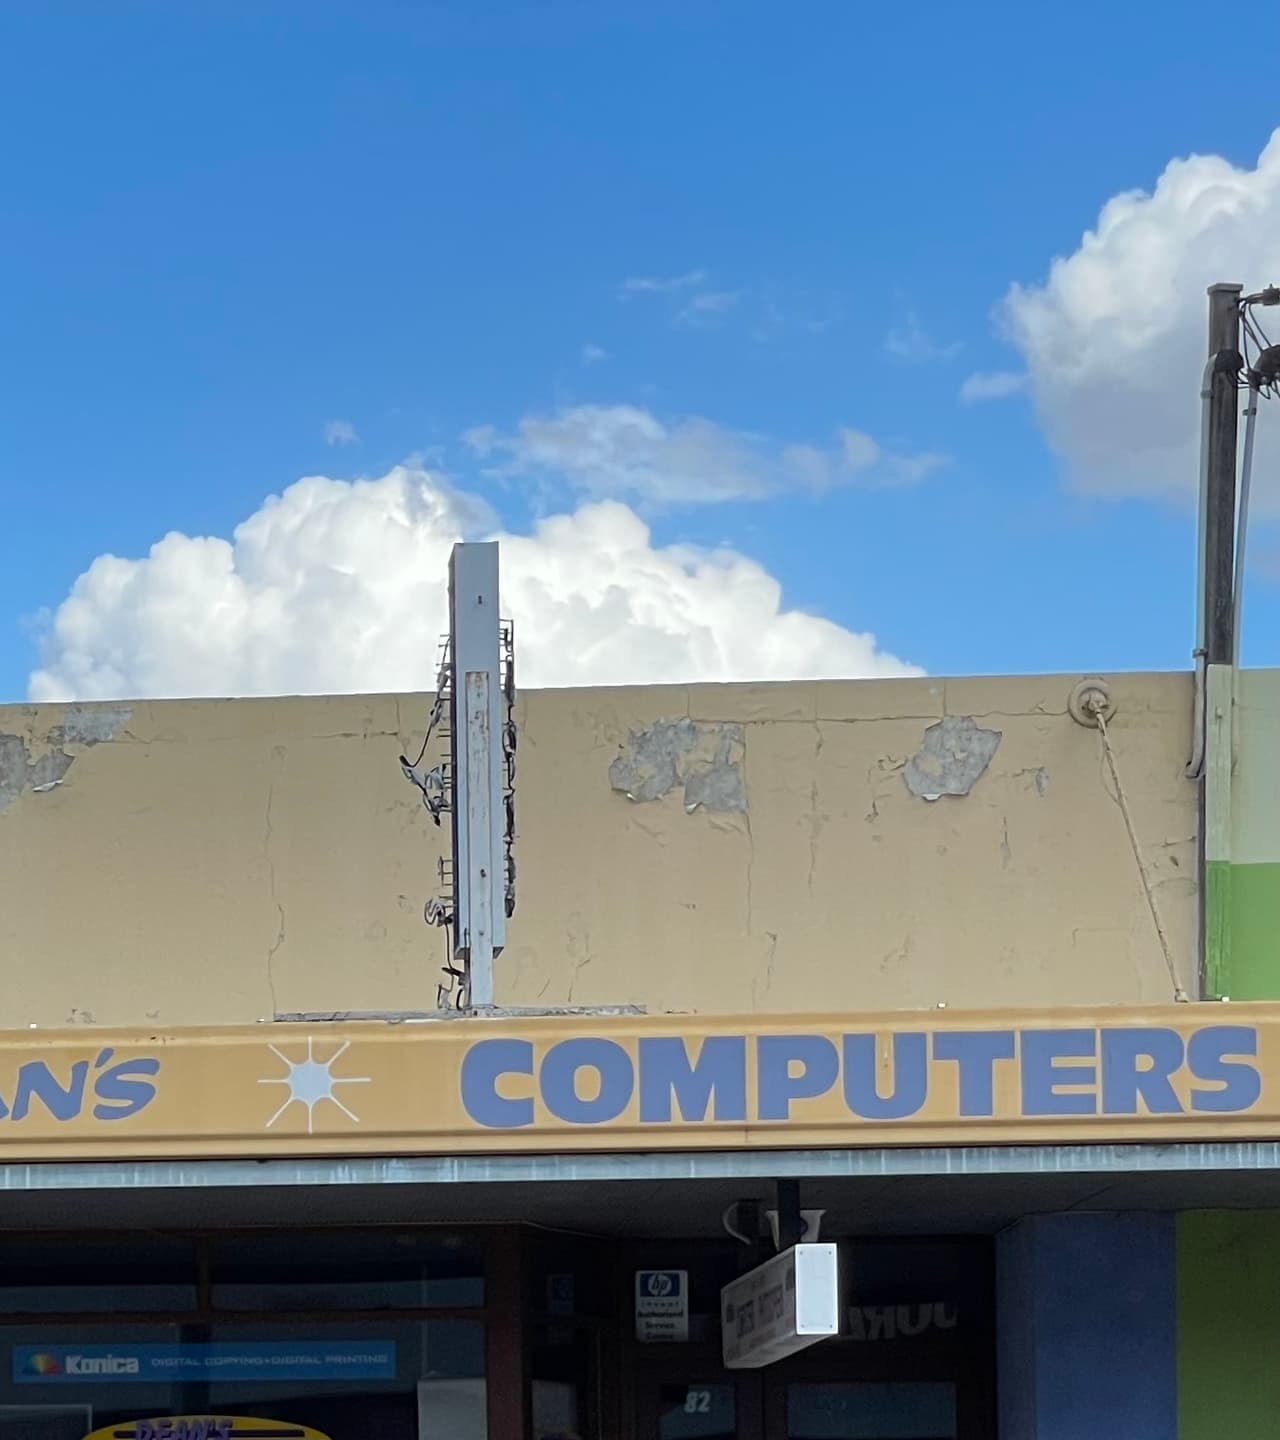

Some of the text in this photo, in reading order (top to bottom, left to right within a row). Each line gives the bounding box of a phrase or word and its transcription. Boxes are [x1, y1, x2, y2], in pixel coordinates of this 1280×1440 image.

[460, 1025, 1262, 1128] COMPUTERS
[65, 1353, 140, 1374] Konica
[684, 1391, 710, 1413] 82
